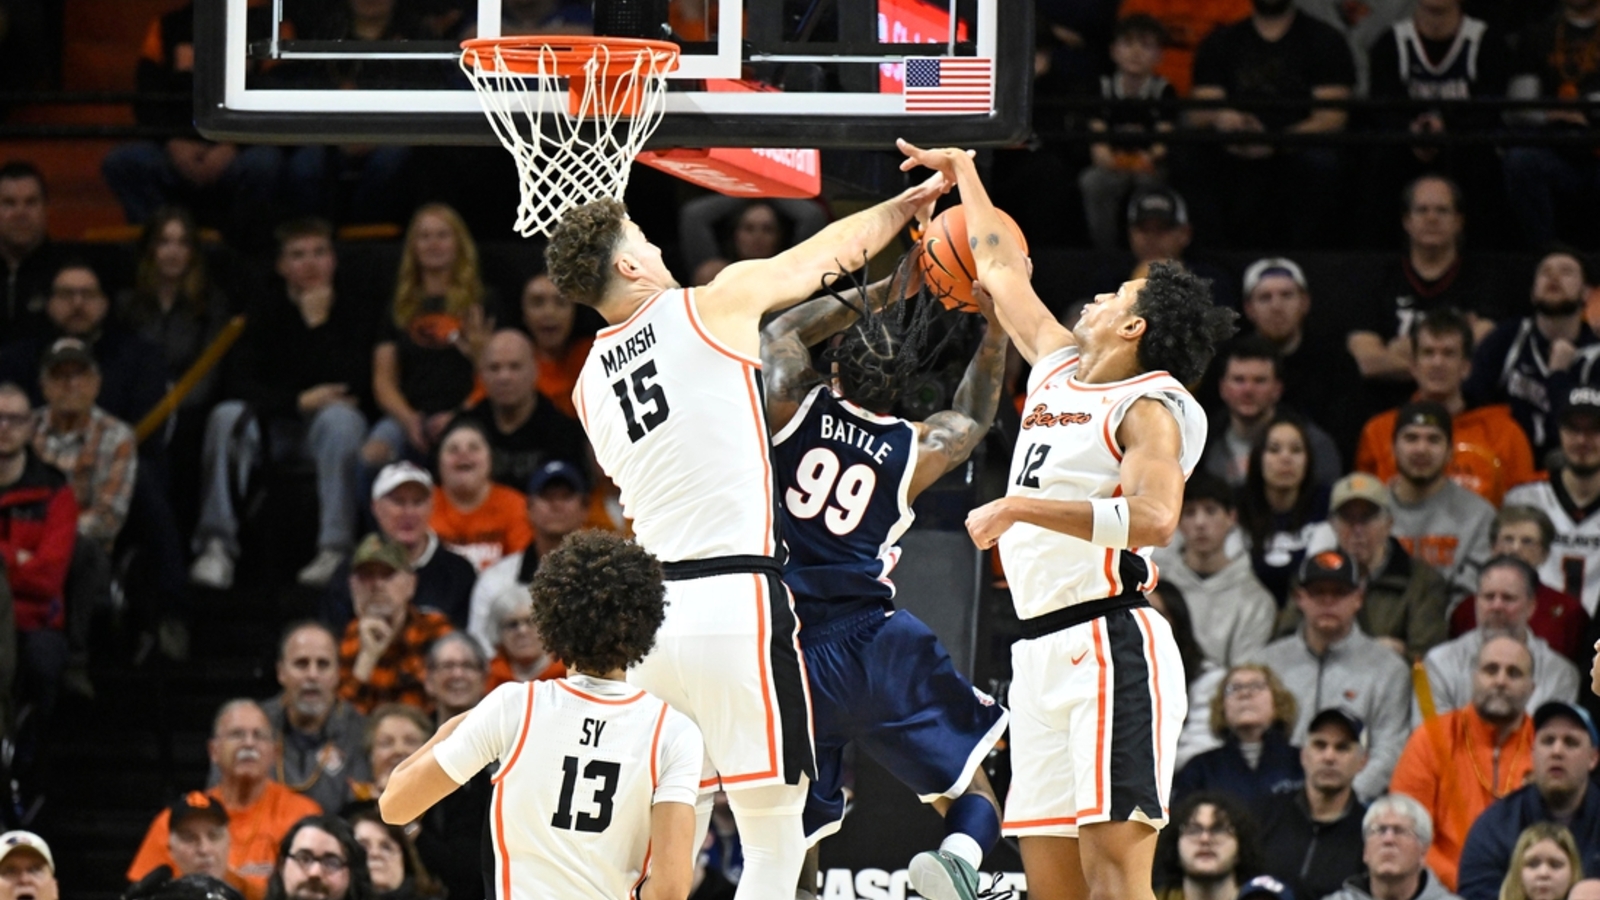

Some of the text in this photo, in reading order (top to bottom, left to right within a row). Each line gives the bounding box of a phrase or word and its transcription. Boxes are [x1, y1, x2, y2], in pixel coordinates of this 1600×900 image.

[599, 322, 656, 378] MARSH
[611, 358, 670, 444] 15
[820, 414, 893, 465] BATTLE
[1015, 442, 1052, 489] 12
[785, 447, 876, 536] 99
[579, 717, 607, 748] SY
[550, 755, 621, 833] 13
